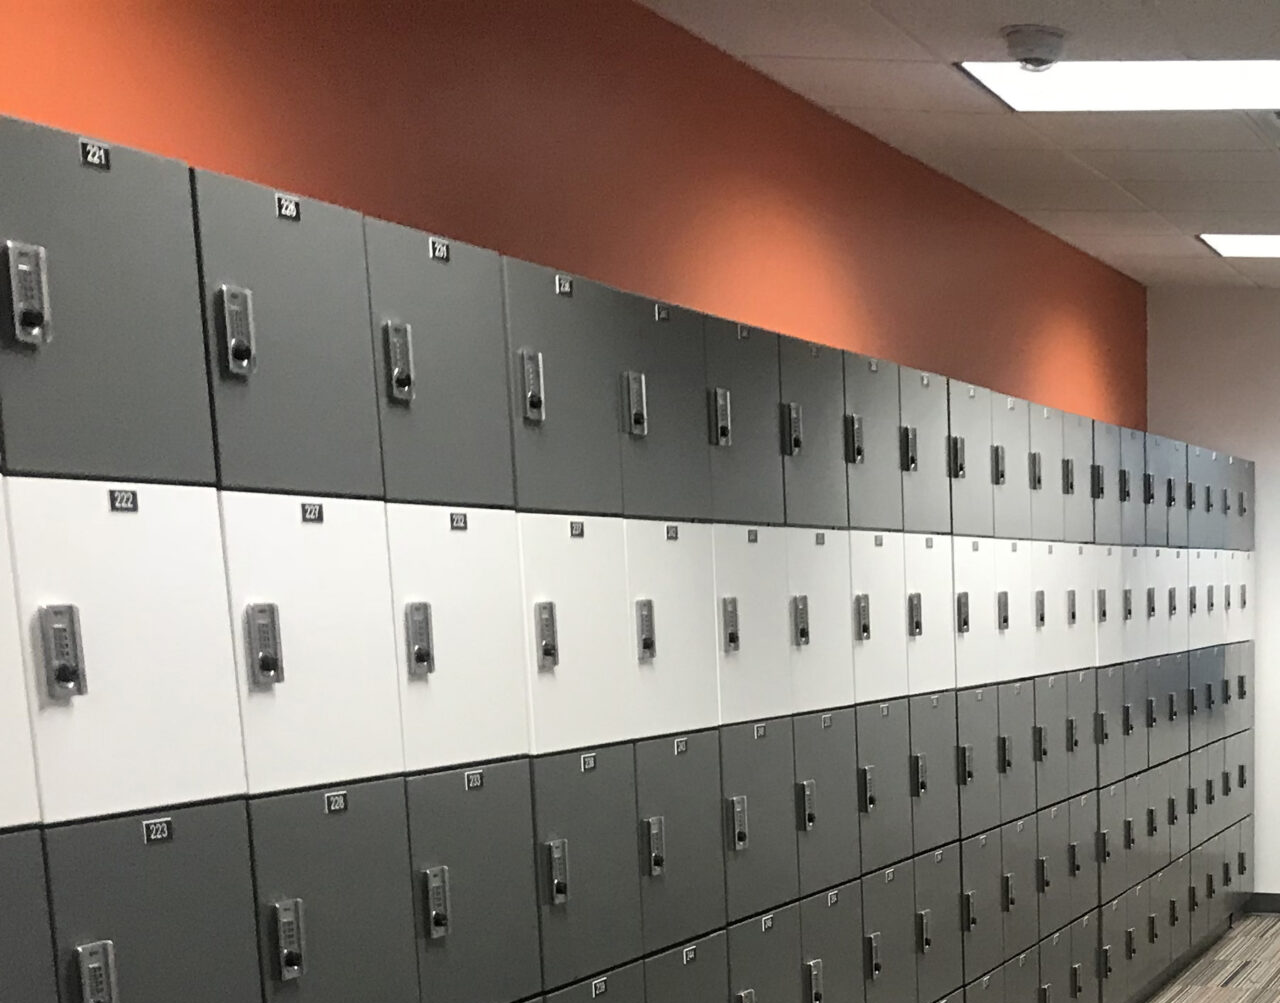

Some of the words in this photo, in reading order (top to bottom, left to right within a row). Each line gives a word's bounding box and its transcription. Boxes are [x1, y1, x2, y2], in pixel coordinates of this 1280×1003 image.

[86, 143, 106, 165] 221
[114, 491, 134, 508] 222
[305, 504, 319, 519] 227
[469, 774, 481, 787] 233
[149, 823, 168, 840] 223
